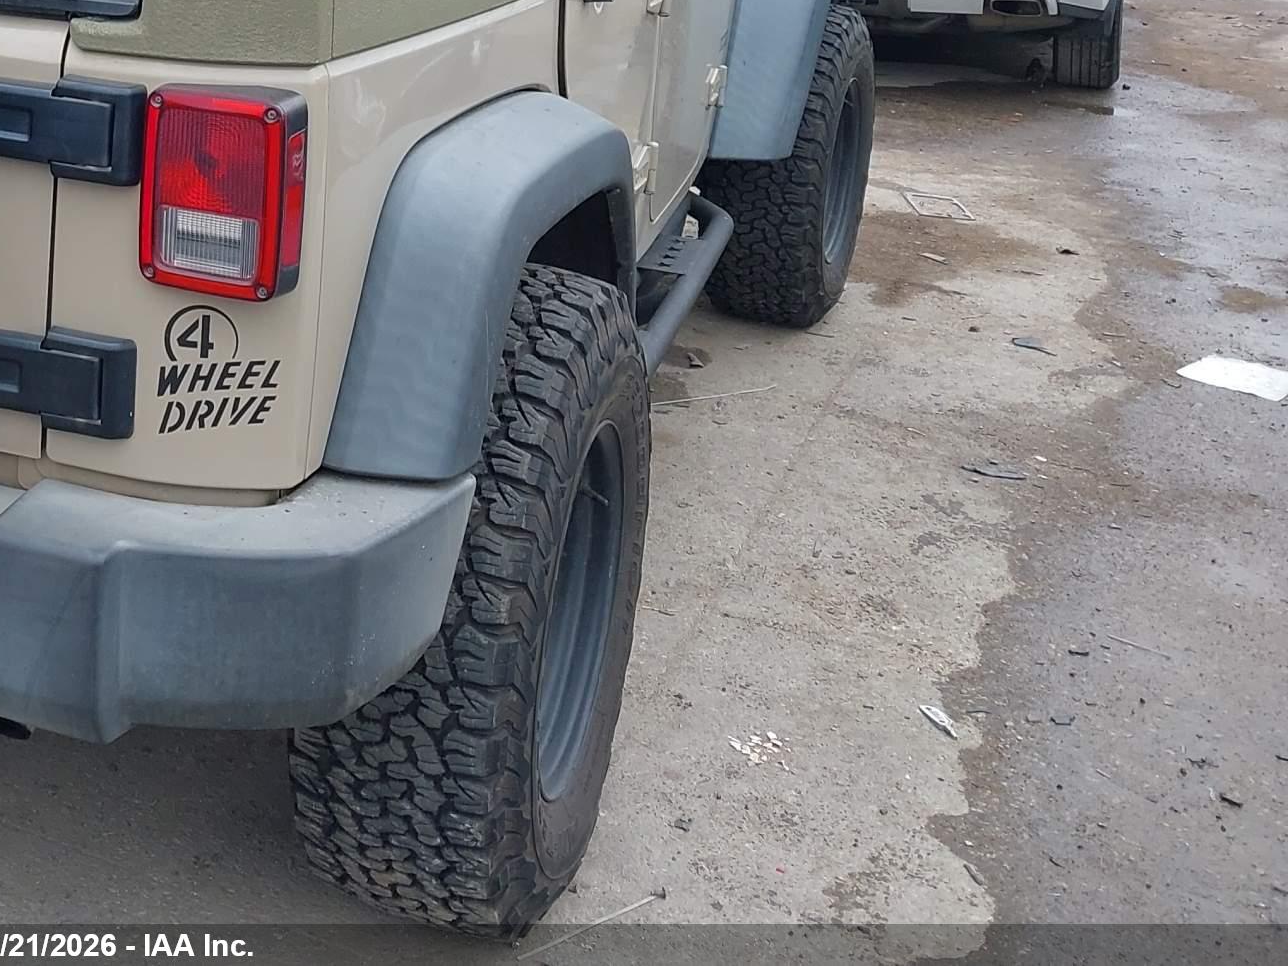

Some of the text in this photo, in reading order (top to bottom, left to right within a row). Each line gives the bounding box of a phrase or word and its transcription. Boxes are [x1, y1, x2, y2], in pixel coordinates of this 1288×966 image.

[176, 314, 214, 359] 4
[156, 360, 281, 398] WHEEL
[158, 395, 277, 434] DRIVE
